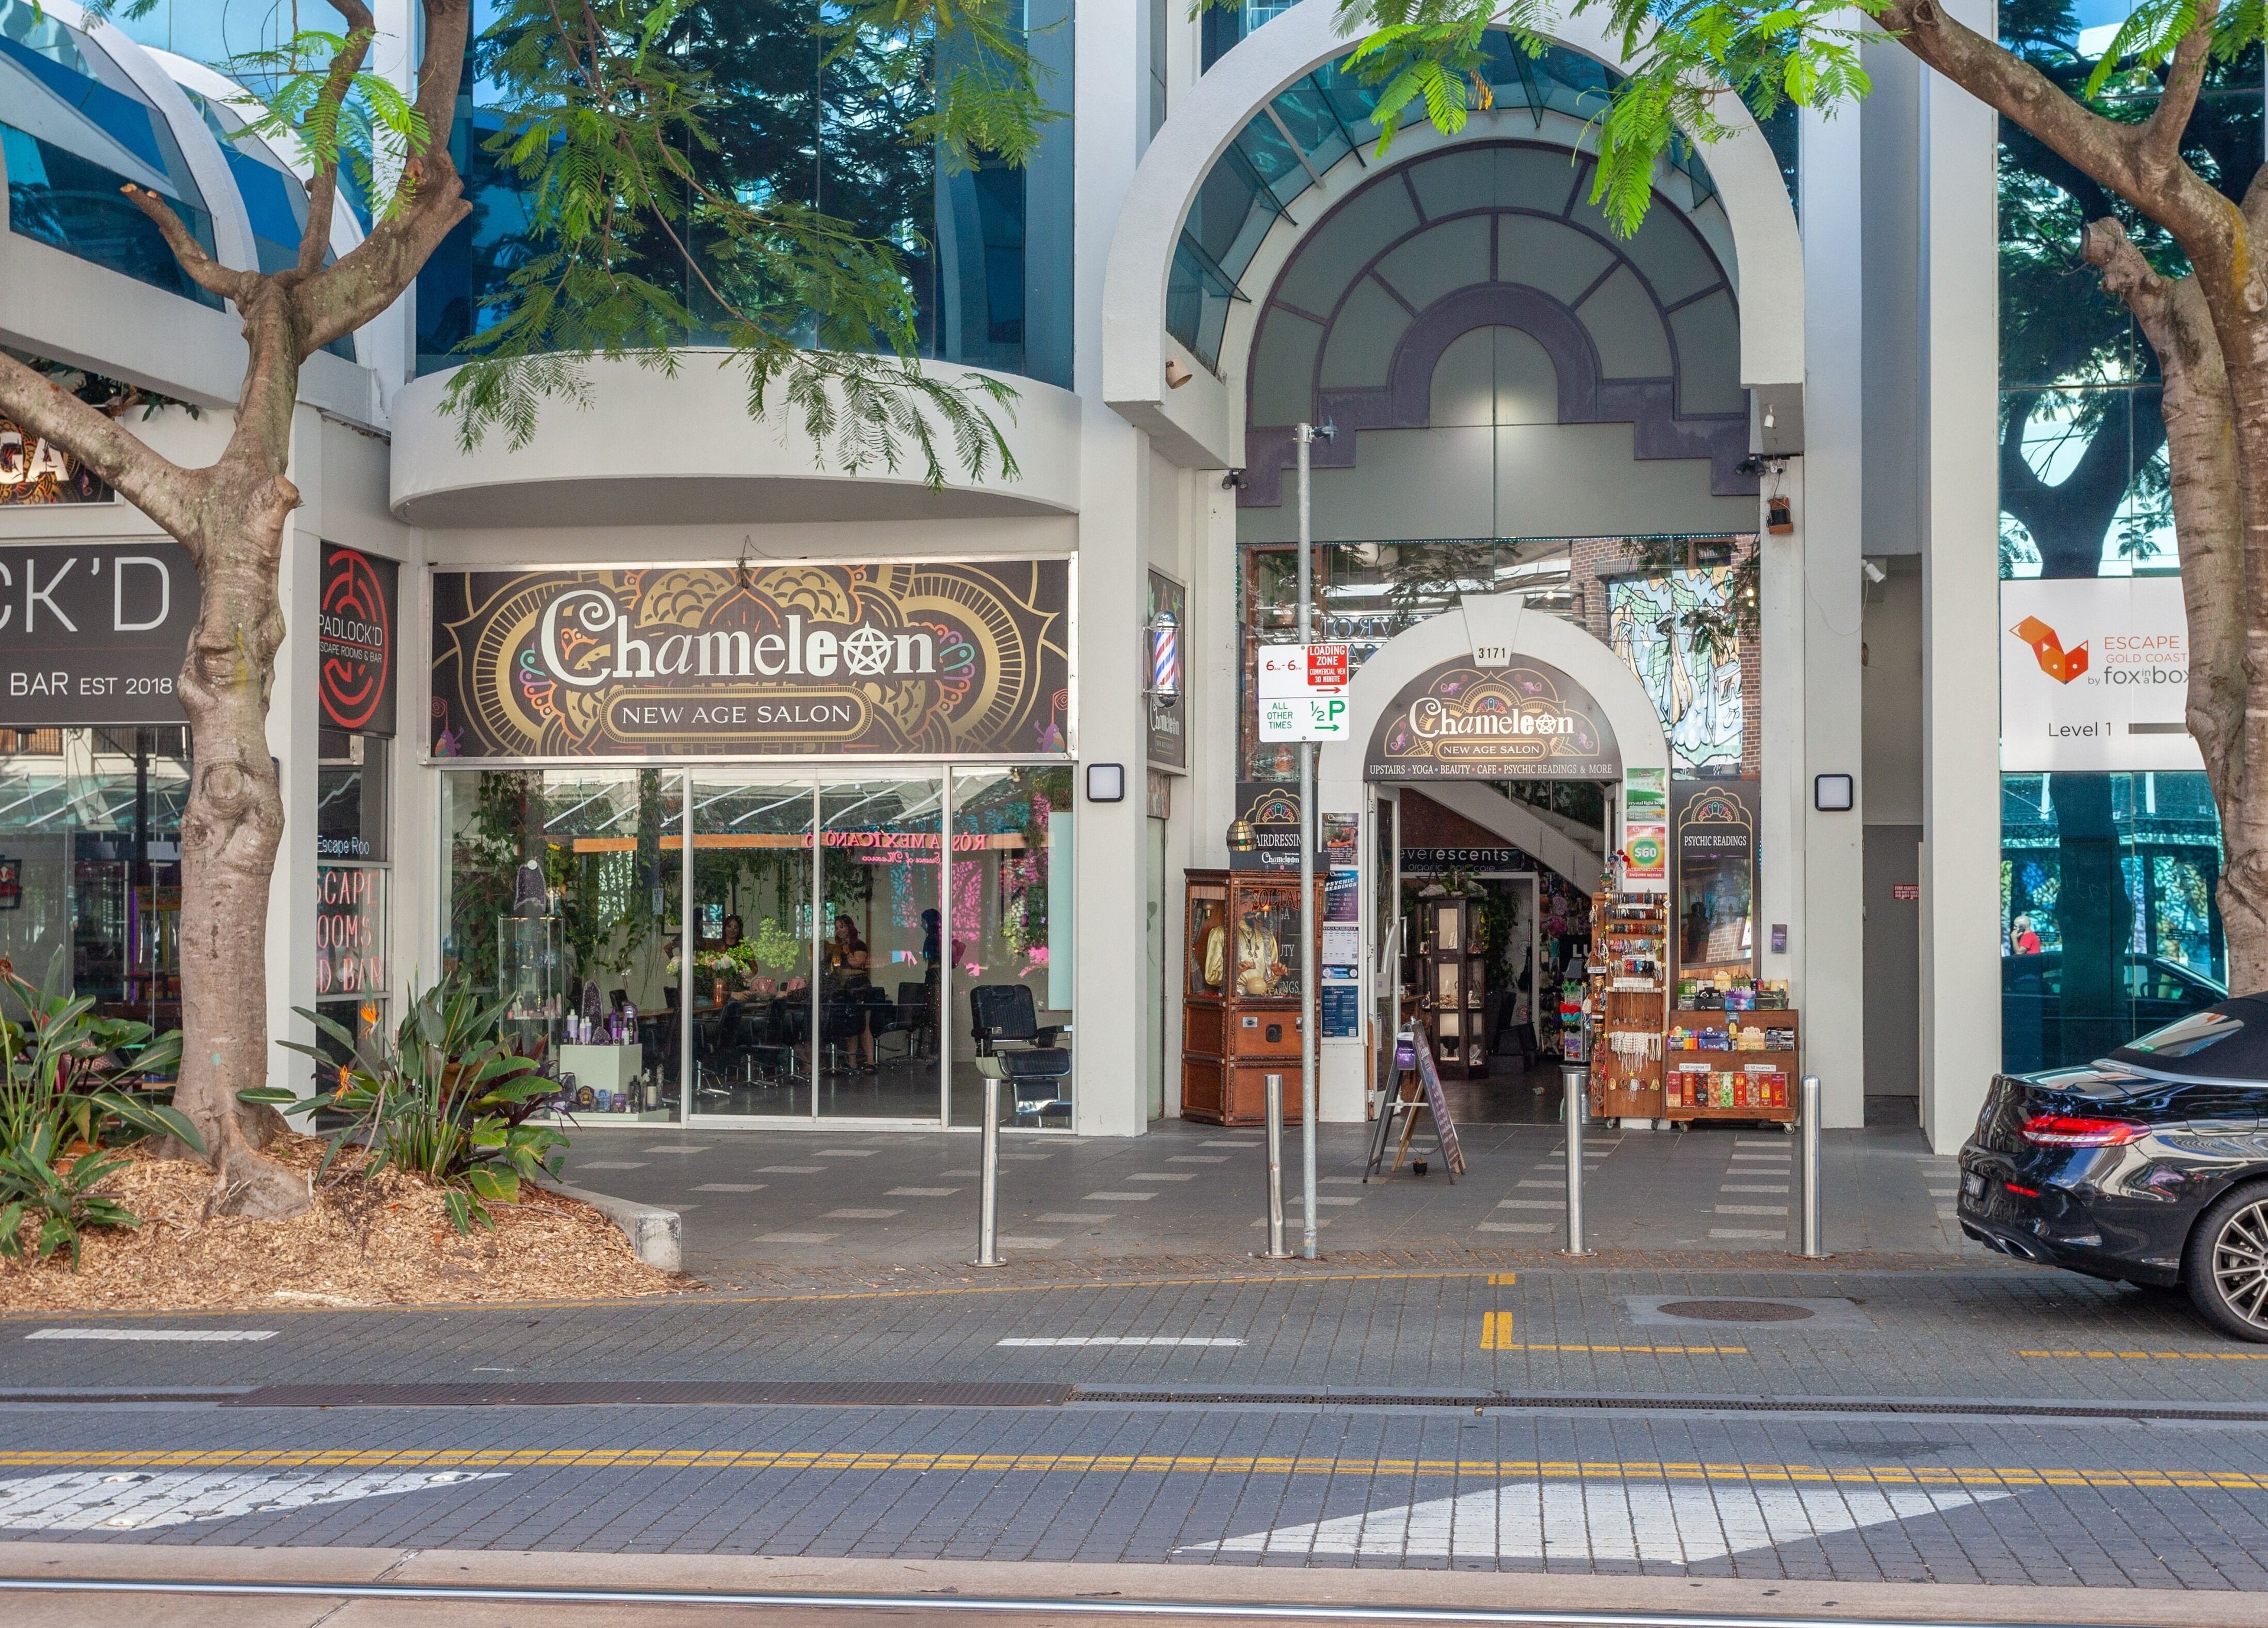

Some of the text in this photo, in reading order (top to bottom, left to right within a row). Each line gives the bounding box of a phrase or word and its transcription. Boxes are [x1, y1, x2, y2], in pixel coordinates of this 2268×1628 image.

[0, 557, 170, 633] K'D
[319, 614, 382, 646] PADLOCK'D
[2105, 636, 2179, 650] ESCAPE
[320, 641, 382, 663] SCAPE ROOMS & BAR
[1309, 646, 1345, 655] LOADING
[1478, 648, 1506, 659] 3171
[1317, 656, 1338, 666] ZONE
[2106, 653, 2188, 663] GOLD COAST
[2088, 676, 2100, 685] by
[2104, 666, 2140, 684] fox
[11, 672, 172, 695] BAR EST 2018
[622, 705, 850, 724] NEW AGE SALON
[2049, 722, 2111, 737] Level 1
[1473, 745, 1496, 754] AGE
[1500, 745, 1539, 754] SALON
[1370, 764, 1612, 774] UPSTAIRS YOGA BEAUTY CAFE PSYCHIC READINGS & MORE
[1256, 833, 1301, 846] AIRDRESSIN
[1684, 836, 1746, 846] PSYCHIC READINGS
[1634, 847, 1657, 858] $60
[1325, 883, 1357, 891] READINGS
[1326, 878, 1354, 887] PSYCHIC
[318, 915, 372, 948] OOMS
